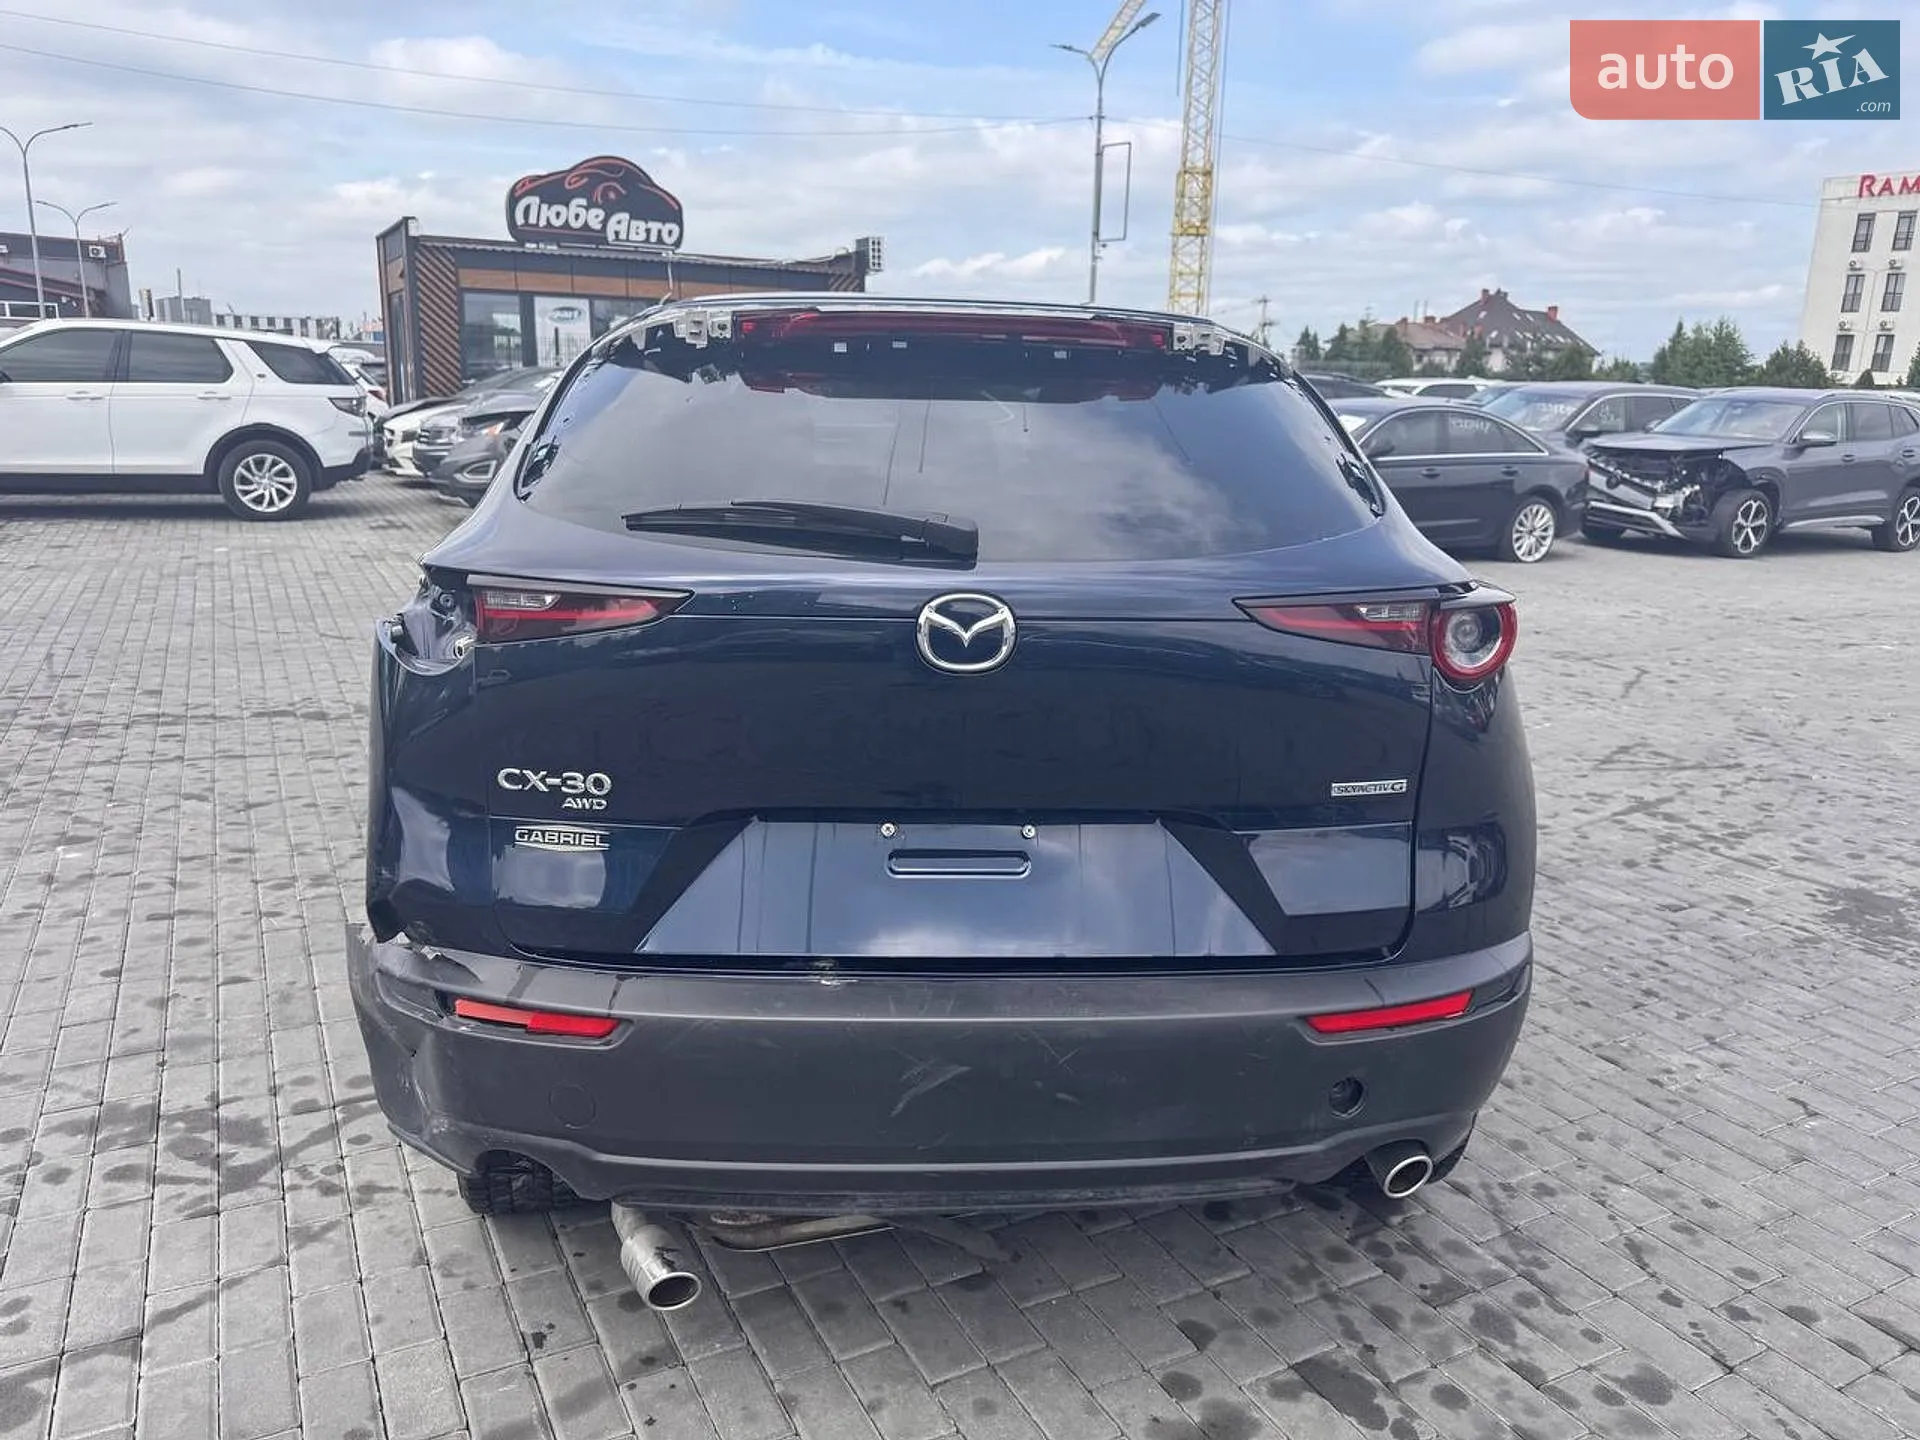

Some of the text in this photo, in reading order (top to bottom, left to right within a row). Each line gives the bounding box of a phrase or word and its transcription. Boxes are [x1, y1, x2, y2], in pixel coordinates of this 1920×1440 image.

[515, 196, 680, 245] Любе Авто
[497, 767, 612, 796] CX-30
[561, 796, 608, 811] AWD
[514, 829, 610, 847] GABRIEL
